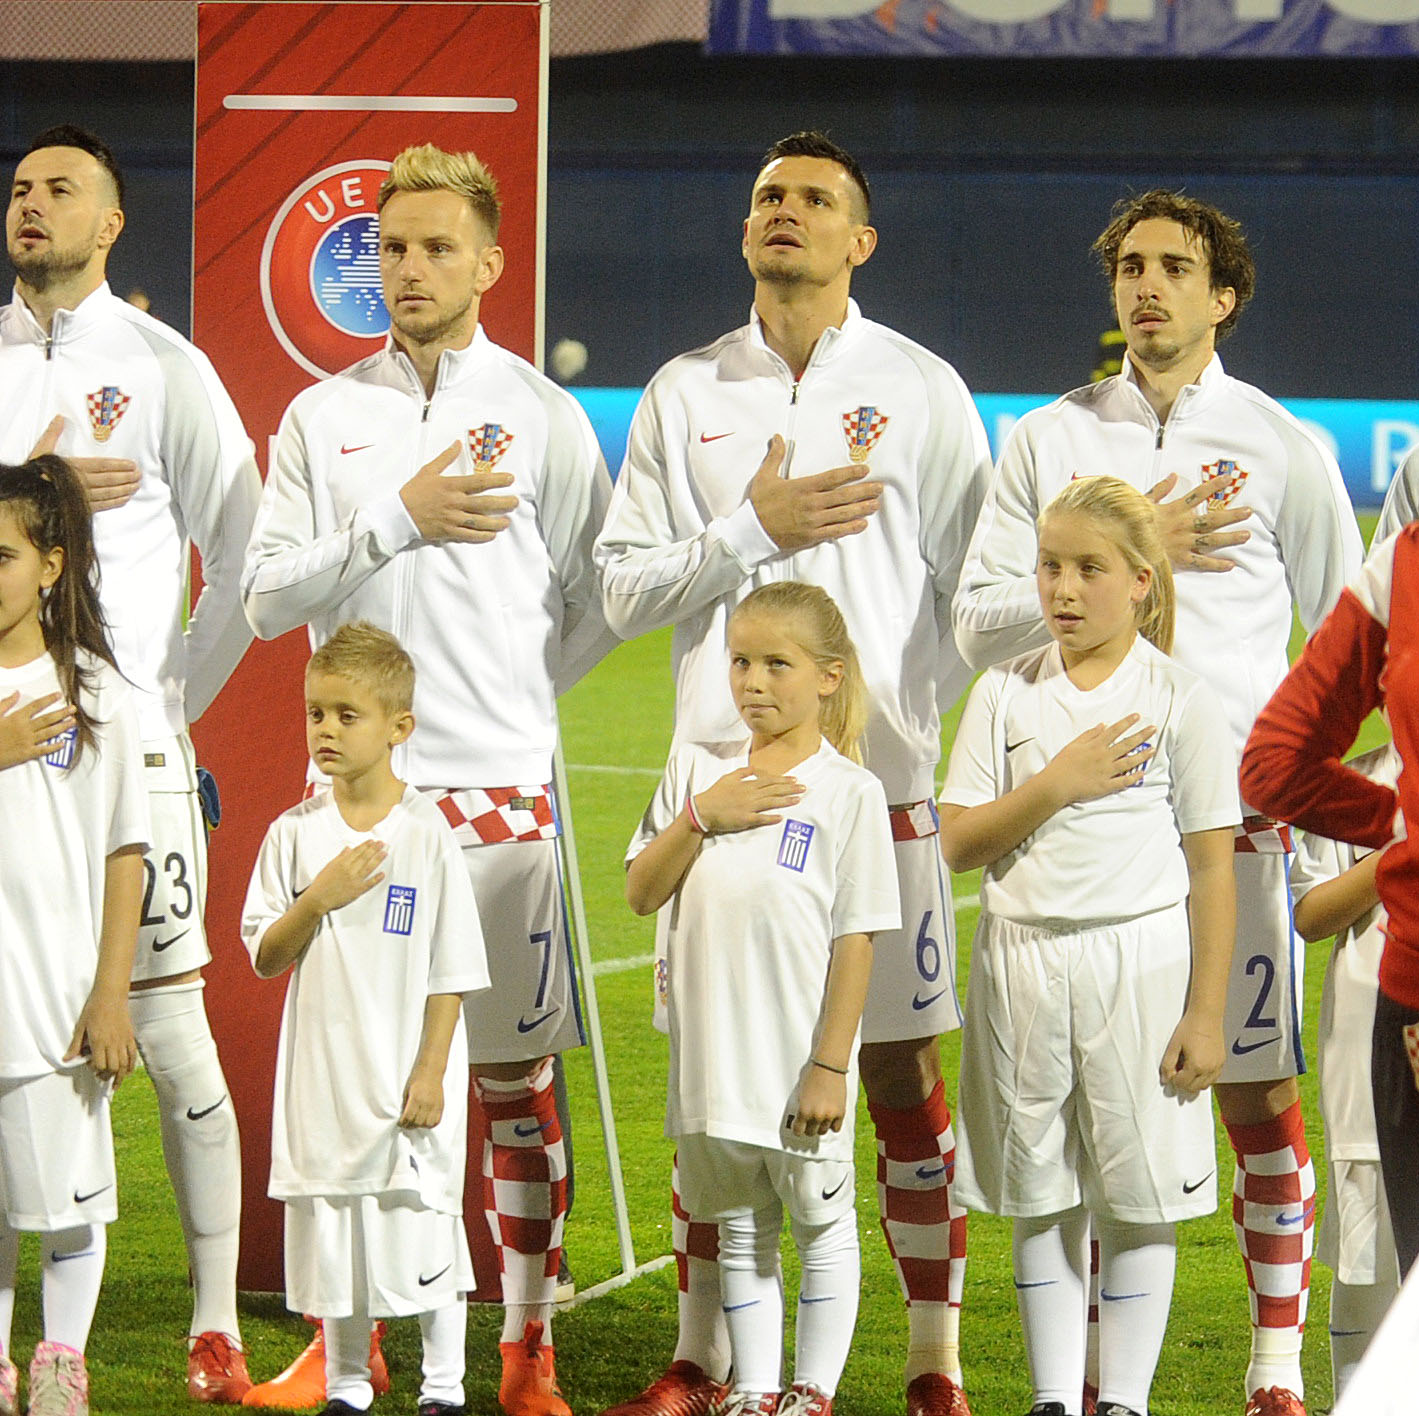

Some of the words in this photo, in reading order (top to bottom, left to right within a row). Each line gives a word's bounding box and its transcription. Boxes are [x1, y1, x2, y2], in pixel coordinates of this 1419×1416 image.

[140, 852, 193, 927] 23
[529, 931, 552, 1008] 7
[915, 909, 941, 983] 6
[1245, 953, 1277, 1029] 2
